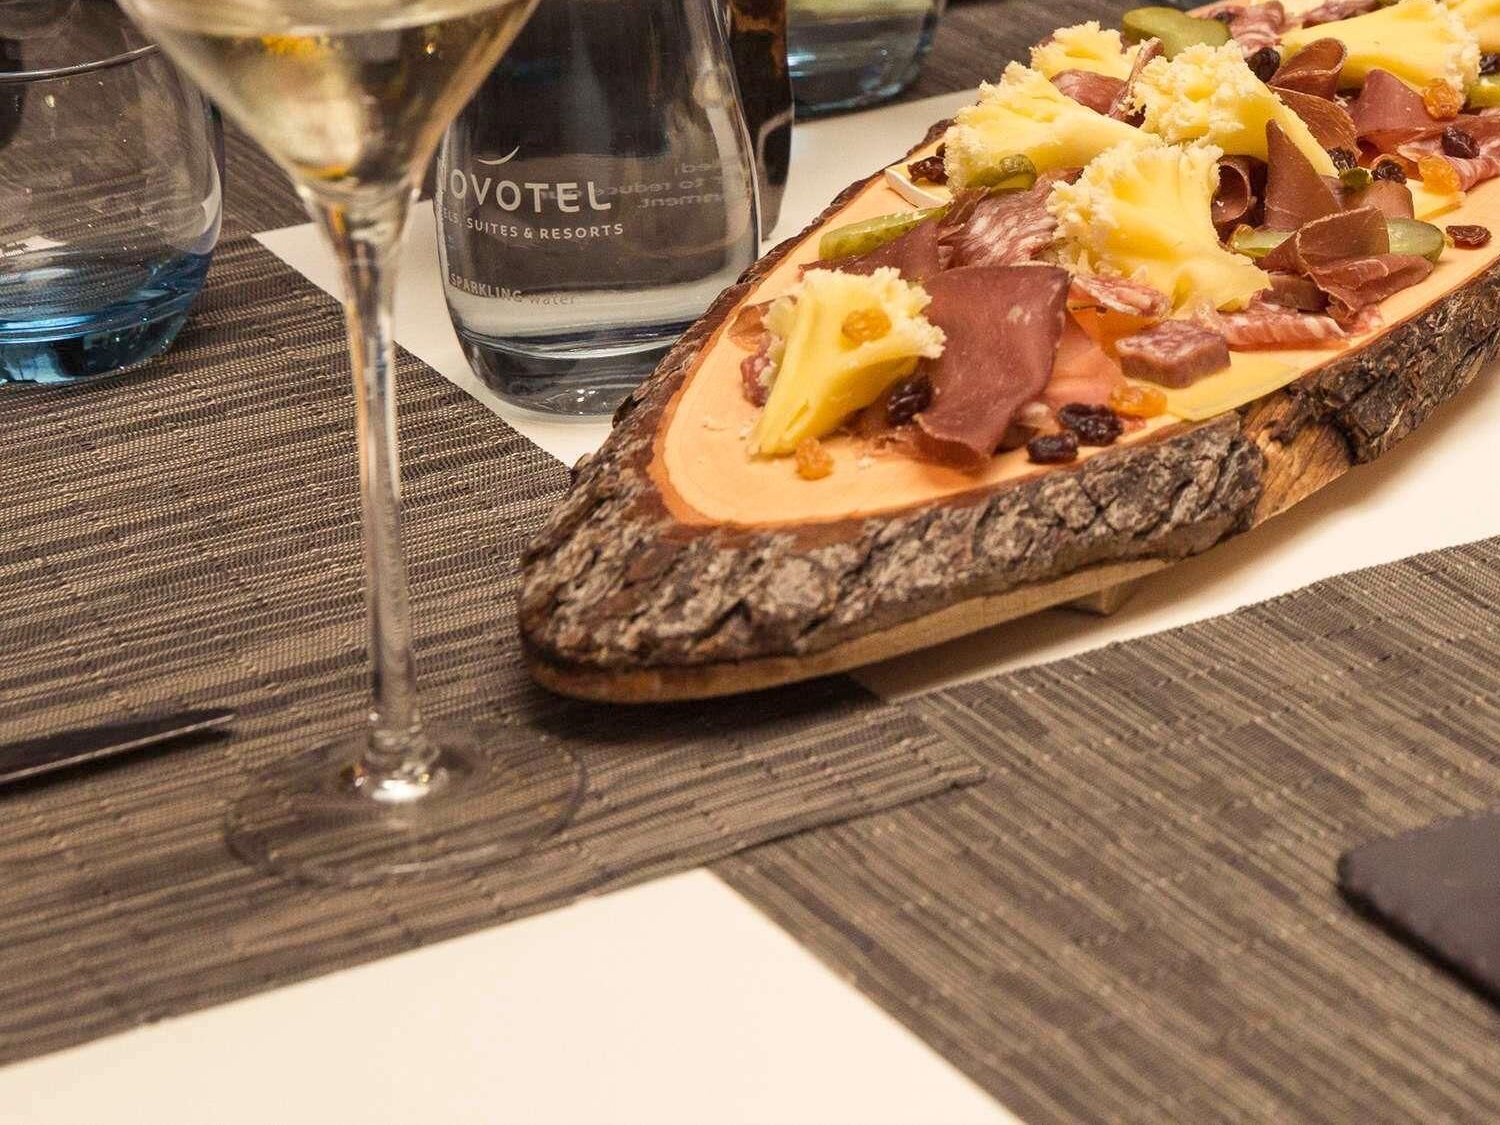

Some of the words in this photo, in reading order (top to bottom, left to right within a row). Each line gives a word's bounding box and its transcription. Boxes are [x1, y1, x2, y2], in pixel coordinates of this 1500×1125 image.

[444, 168, 612, 213] OVOTEL
[466, 217, 519, 237] SUITES
[524, 227, 534, 239] &
[540, 223, 624, 240] RESORTS
[450, 273, 523, 303] SPARKLING
[529, 293, 577, 306] water
